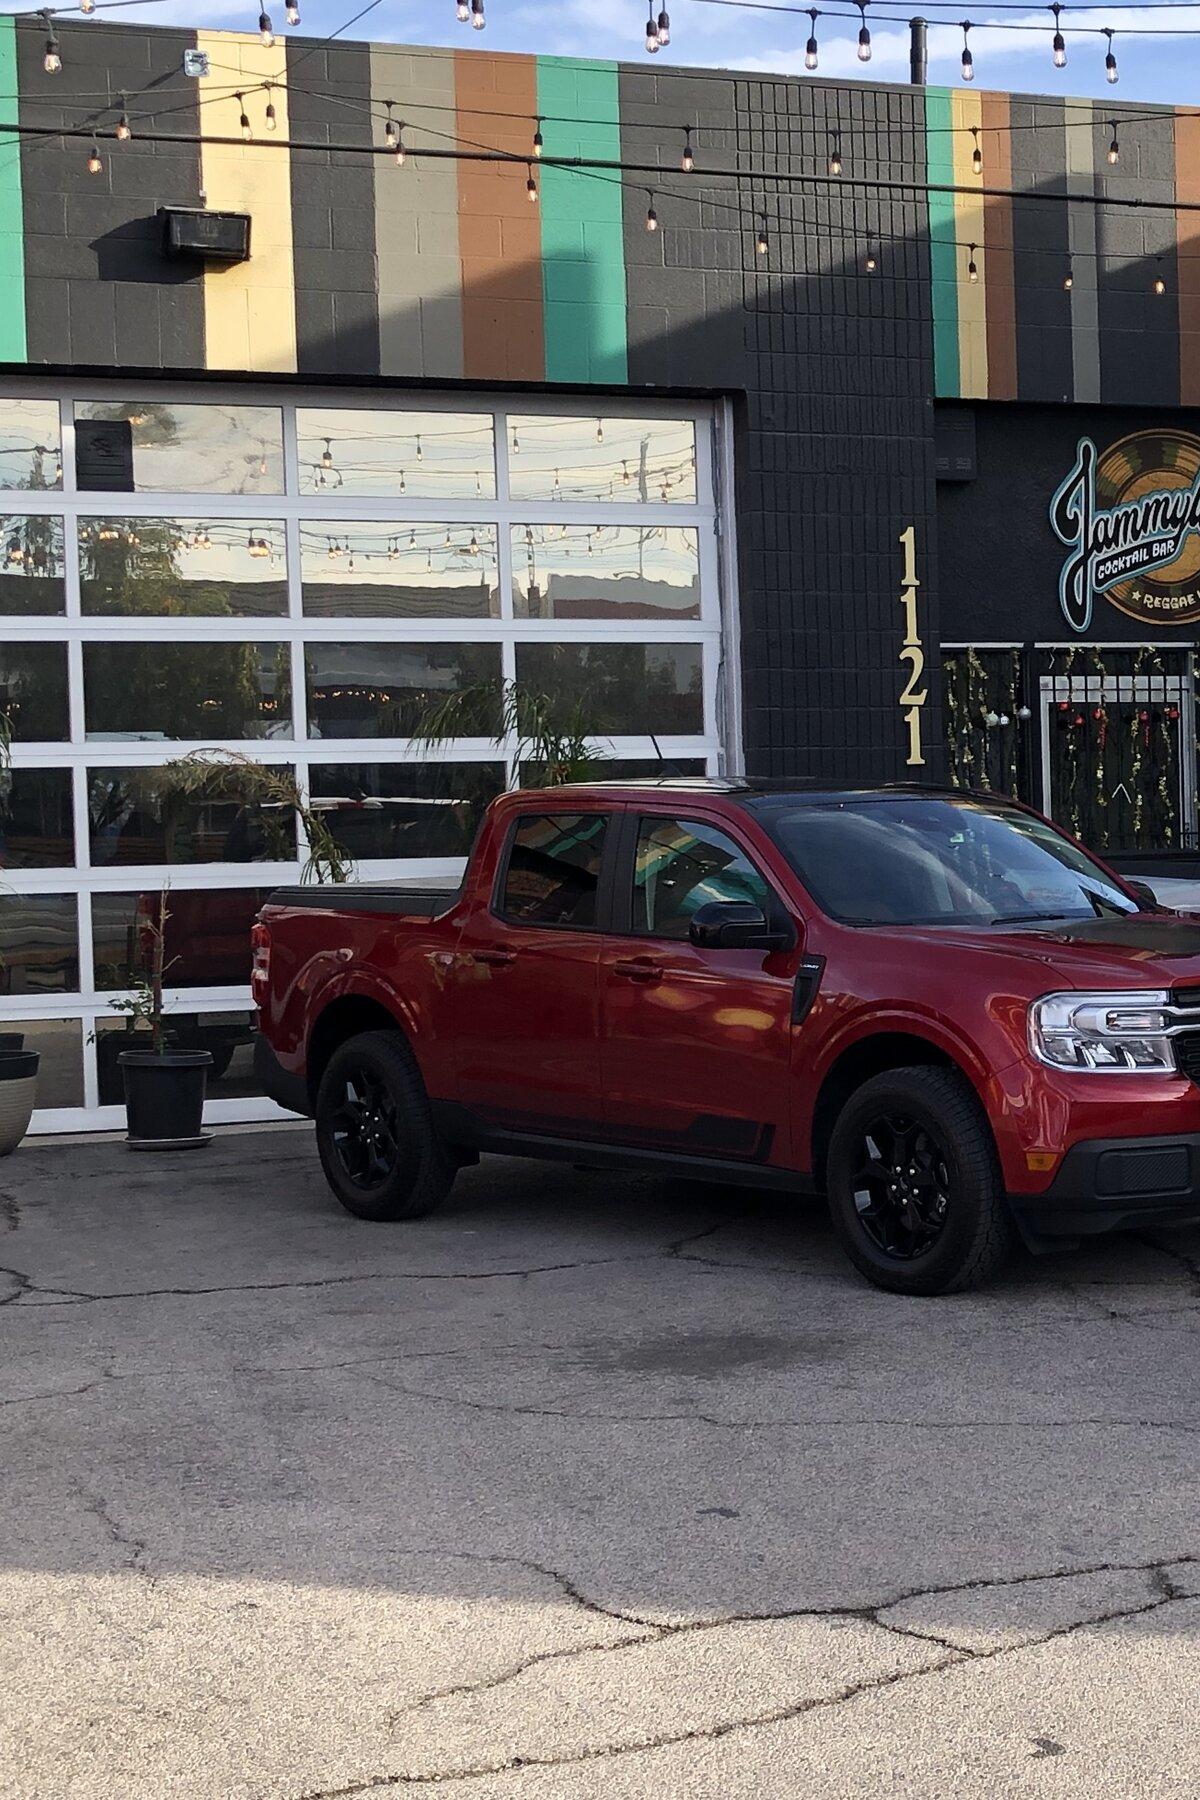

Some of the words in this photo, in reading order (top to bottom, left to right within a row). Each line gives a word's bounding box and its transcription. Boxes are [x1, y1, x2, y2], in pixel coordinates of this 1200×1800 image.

[1097, 548, 1149, 580] COCKTAIL
[1152, 540, 1175, 557] BAR
[1143, 594, 1195, 609] REGGAE
[899, 526, 928, 765] 1121
